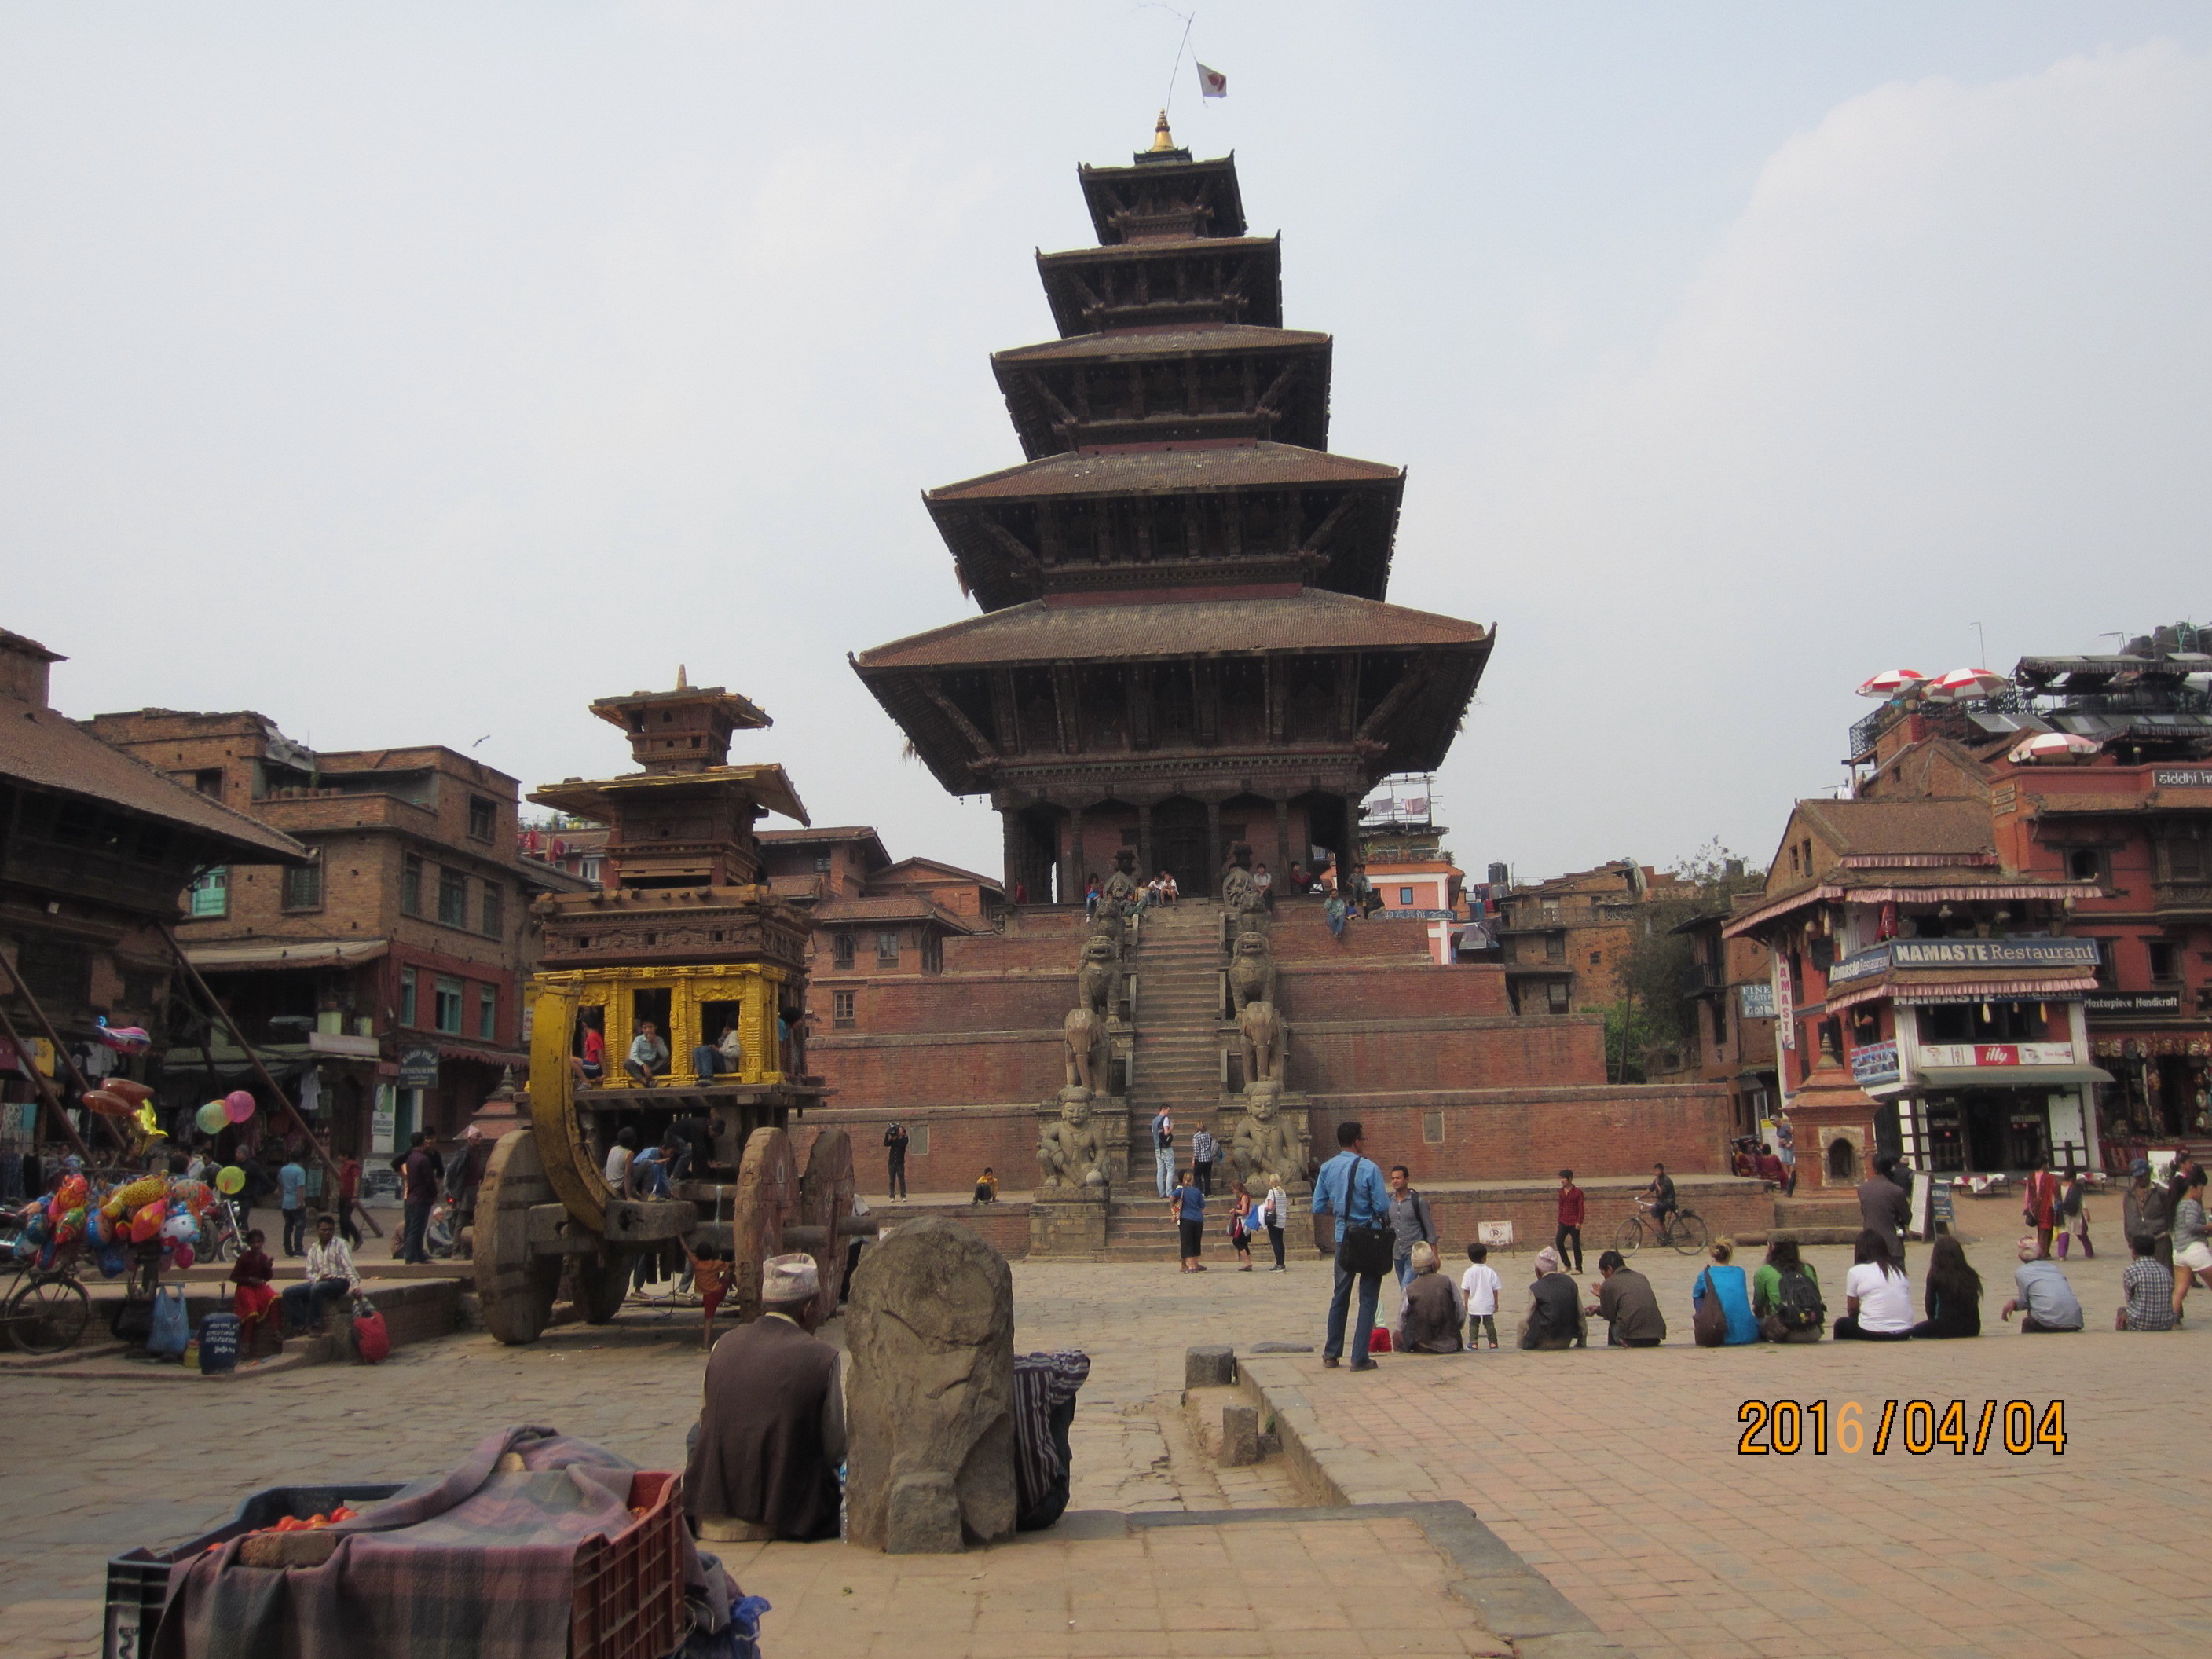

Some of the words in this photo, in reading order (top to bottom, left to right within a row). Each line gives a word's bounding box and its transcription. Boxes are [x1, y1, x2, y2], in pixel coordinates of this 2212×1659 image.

[1895, 945, 1988, 961] NAMASTE
[1990, 944, 2095, 960] Restaurant
[1829, 960, 1860, 981] Namaste
[1743, 985, 1771, 994] FINE
[1778, 954, 1790, 1044] NAMASTE
[2084, 998, 2132, 1010] Masterpiece
[2136, 997, 2177, 1009] Handicraft
[1985, 1047, 2008, 1064] illy
